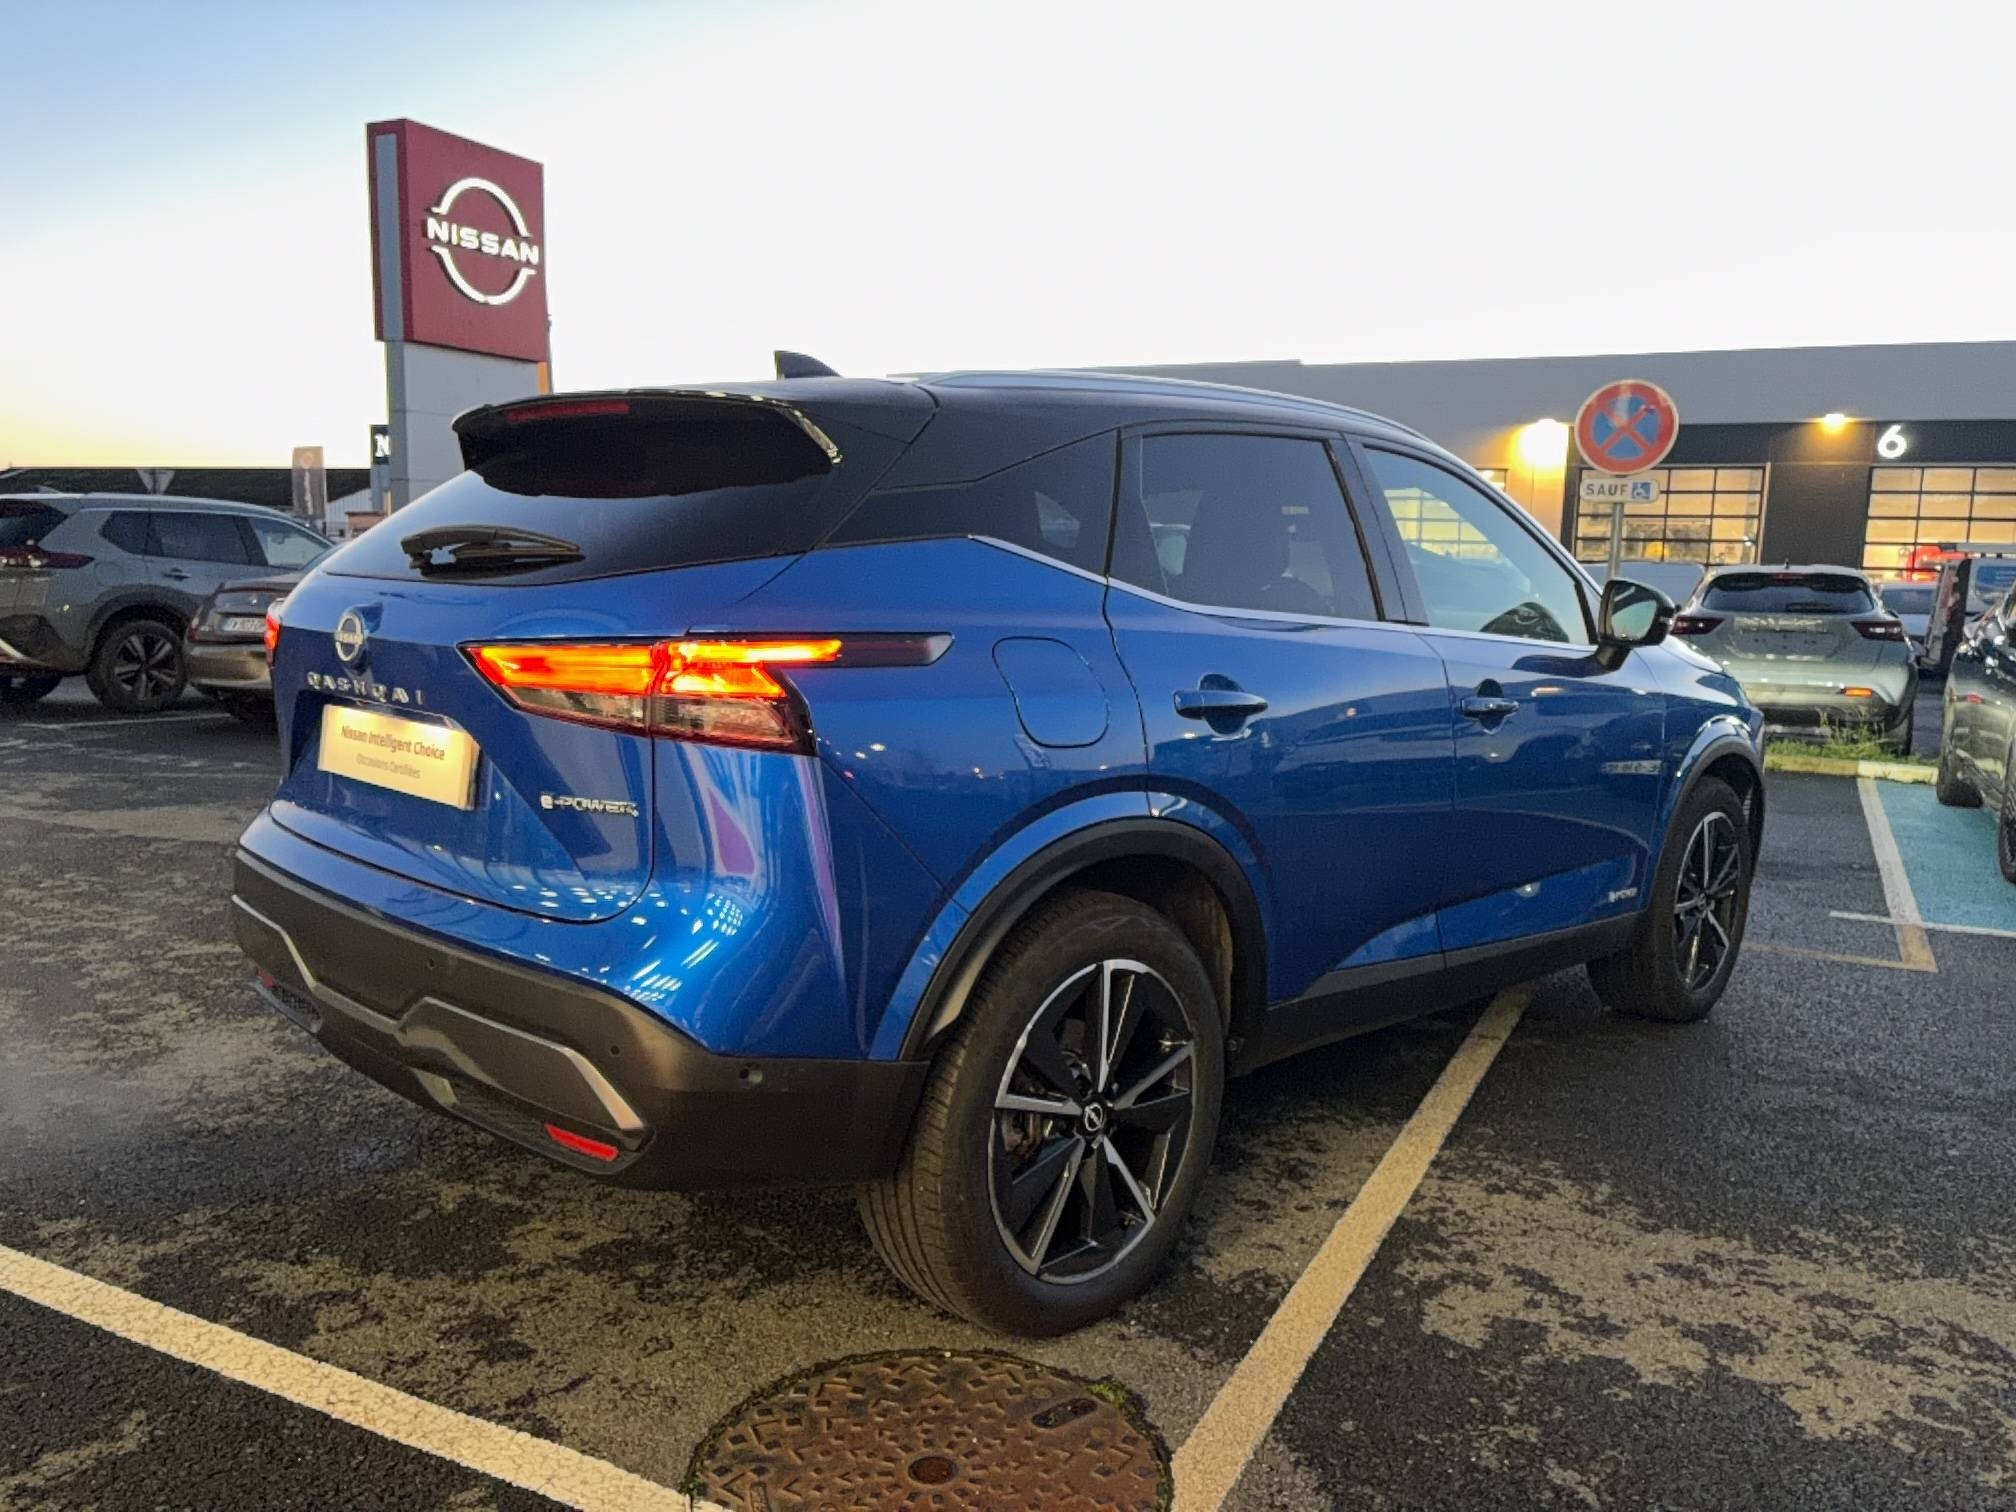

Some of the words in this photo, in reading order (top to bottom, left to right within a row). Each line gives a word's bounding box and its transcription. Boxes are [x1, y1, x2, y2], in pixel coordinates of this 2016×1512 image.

[426, 217, 540, 265] NISSAN
[1877, 424, 1907, 459] 6
[1585, 483, 1628, 497] SAUF
[307, 671, 425, 704] QASHQAI
[341, 725, 368, 744] Nissan
[368, 731, 412, 753] Intelligent
[414, 741, 445, 760] Choice
